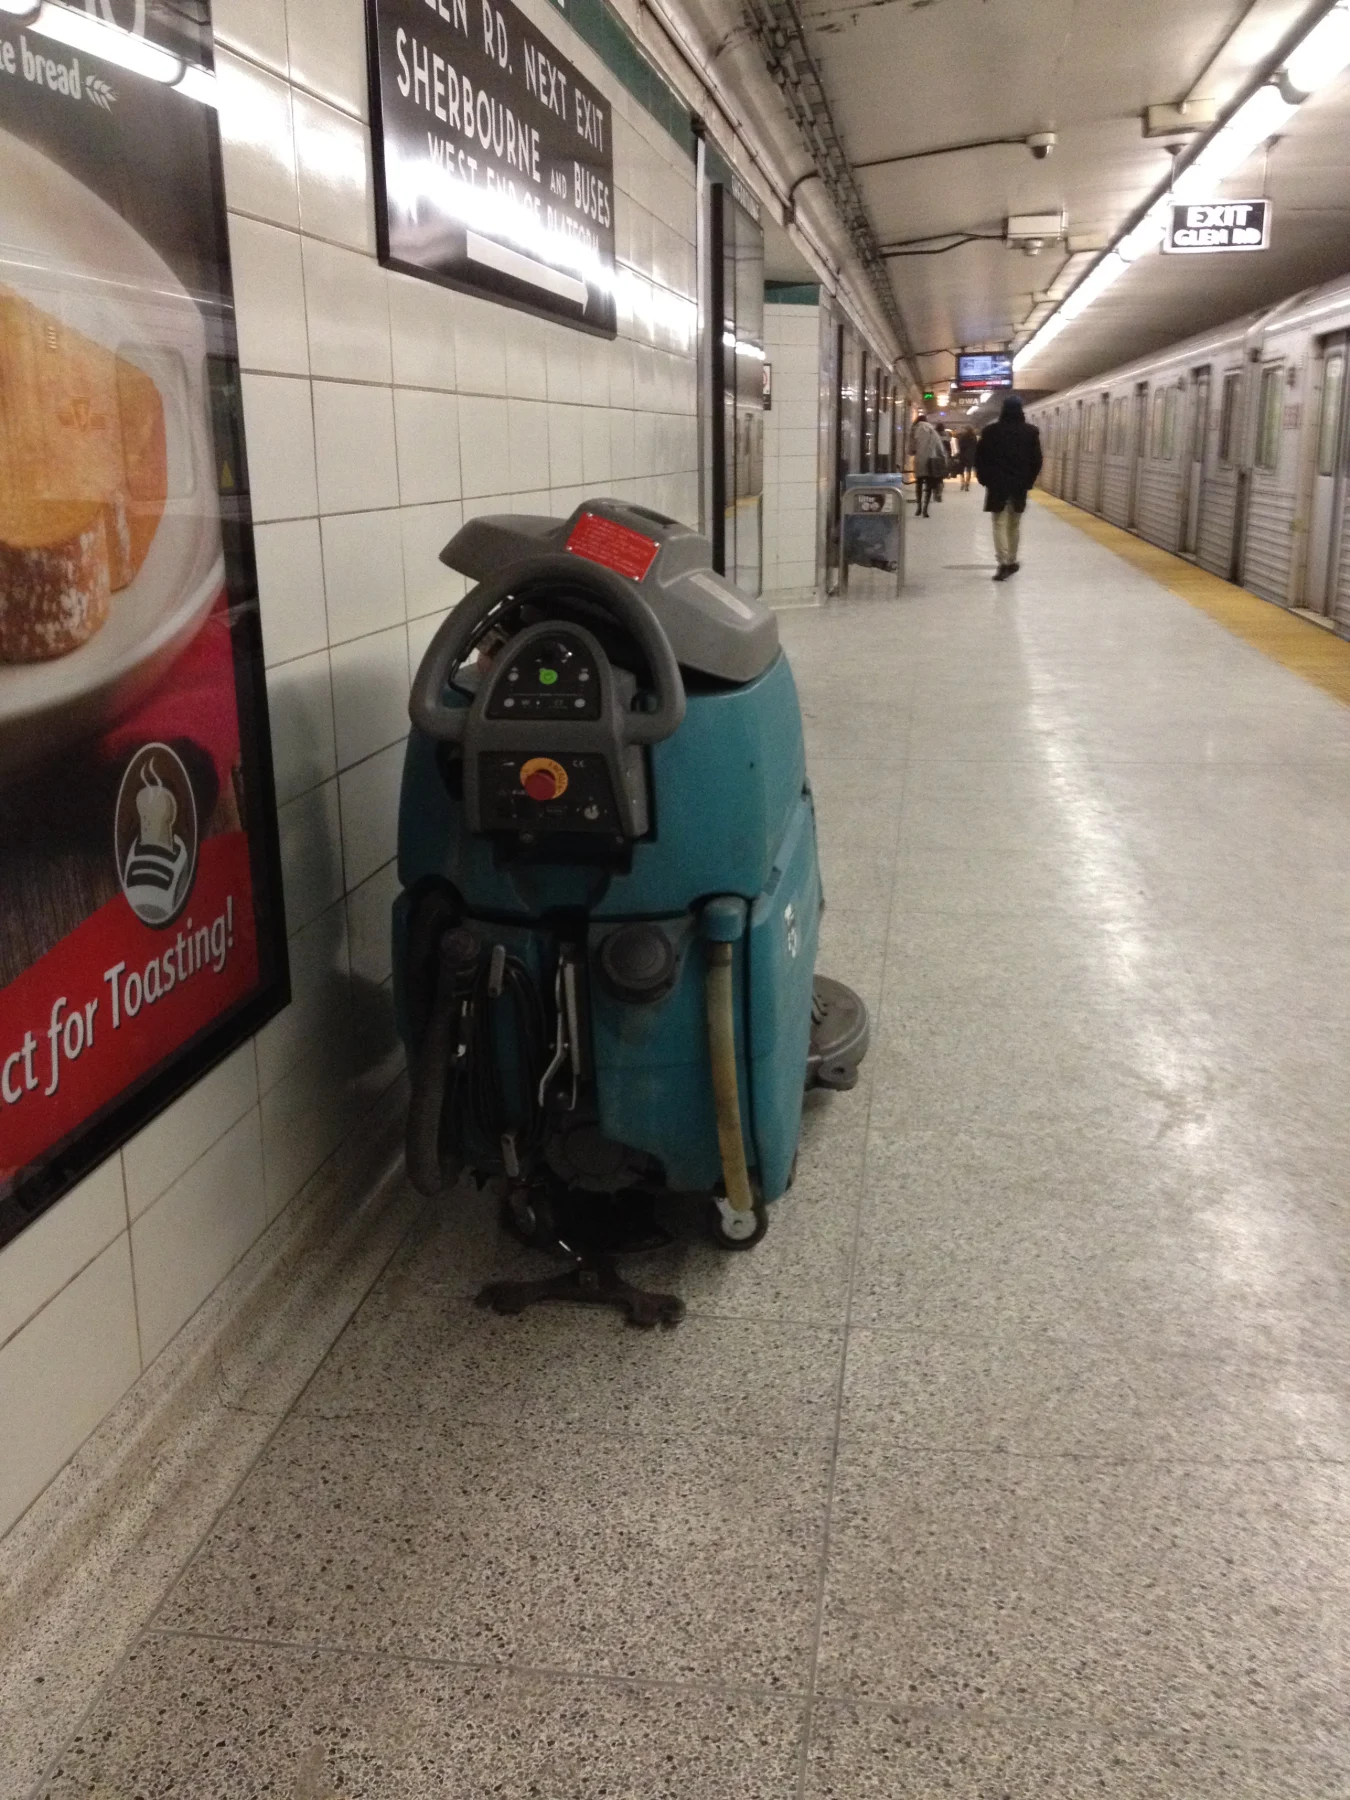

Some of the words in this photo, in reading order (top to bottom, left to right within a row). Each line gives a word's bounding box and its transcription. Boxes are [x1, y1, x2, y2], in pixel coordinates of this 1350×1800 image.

[20, 34, 82, 100] bread
[482, 0, 513, 75] RD.
[524, 36, 567, 121] NEXT
[575, 87, 604, 153] EXIT
[396, 27, 541, 182] SHERBOURNE
[550, 168, 568, 200] AND
[574, 160, 611, 229] BUSES
[427, 131, 478, 188] WEST
[1186, 204, 1254, 228] EXIT
[44, 996, 98, 1096] for
[104, 895, 234, 1030] Toasting!
